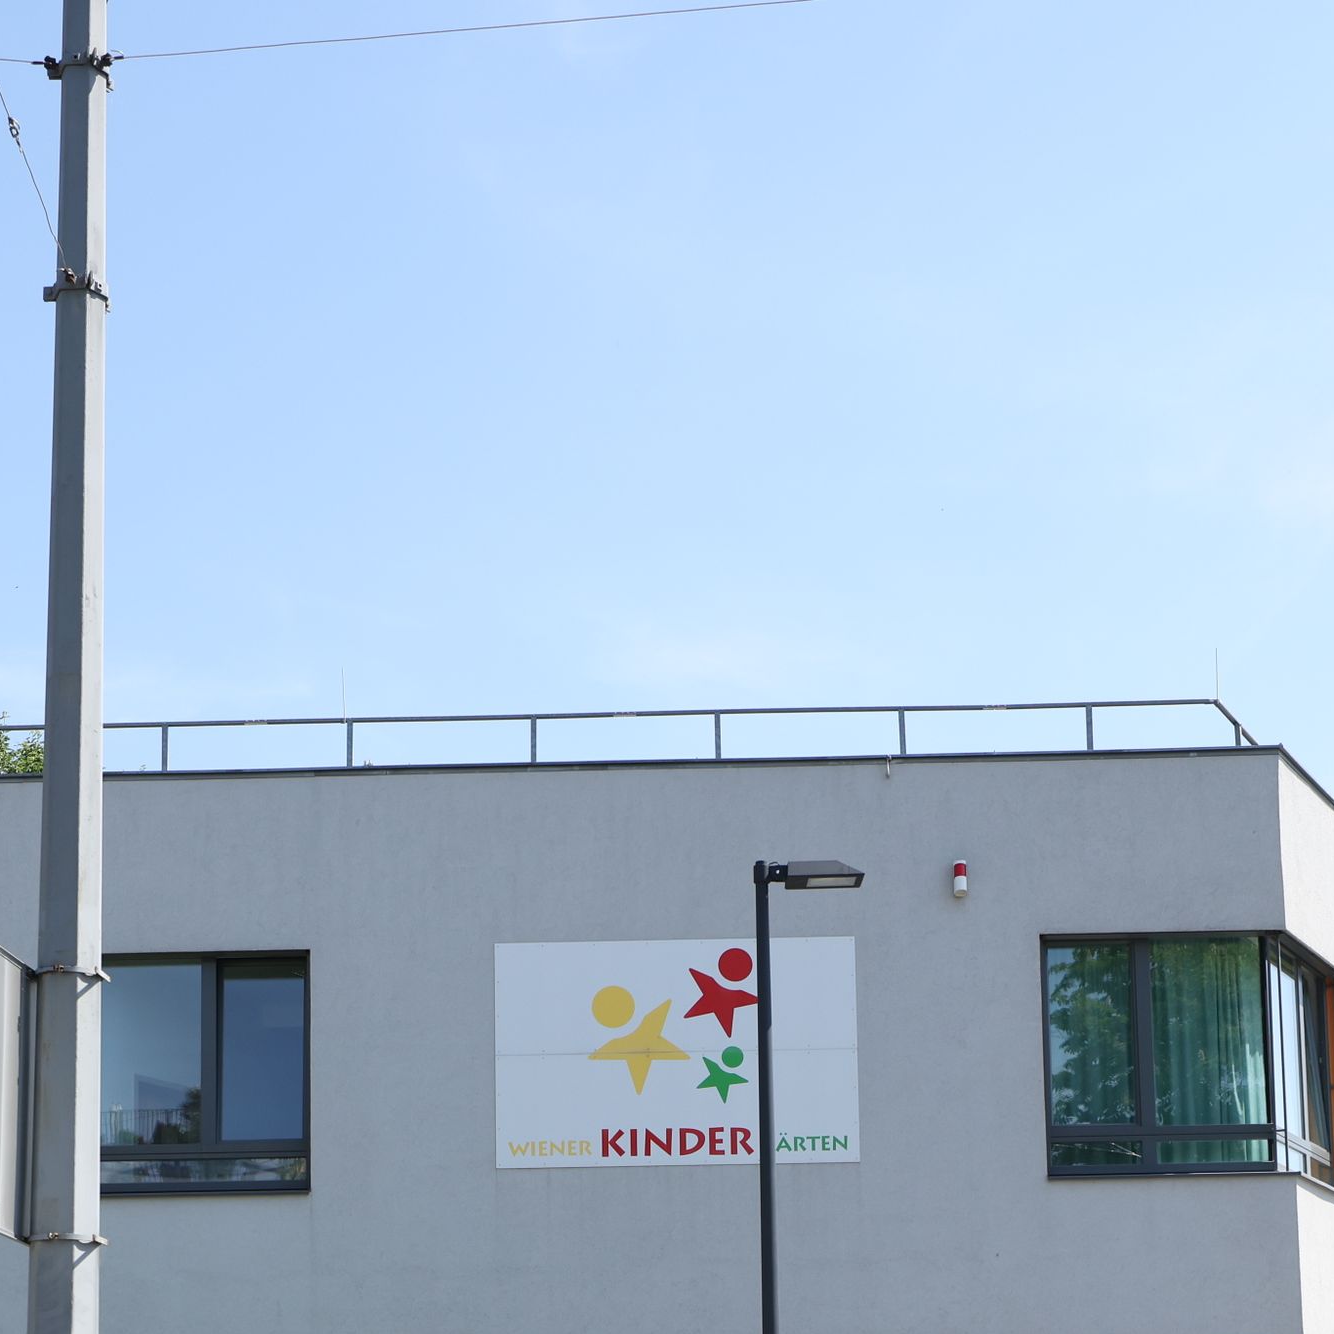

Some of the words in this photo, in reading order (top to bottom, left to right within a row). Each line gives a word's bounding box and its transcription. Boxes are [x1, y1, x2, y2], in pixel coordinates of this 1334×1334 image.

[508, 1140, 592, 1157] WIENER
[601, 1126, 755, 1158] KINDER
[775, 1132, 849, 1152] ÄRTEN
